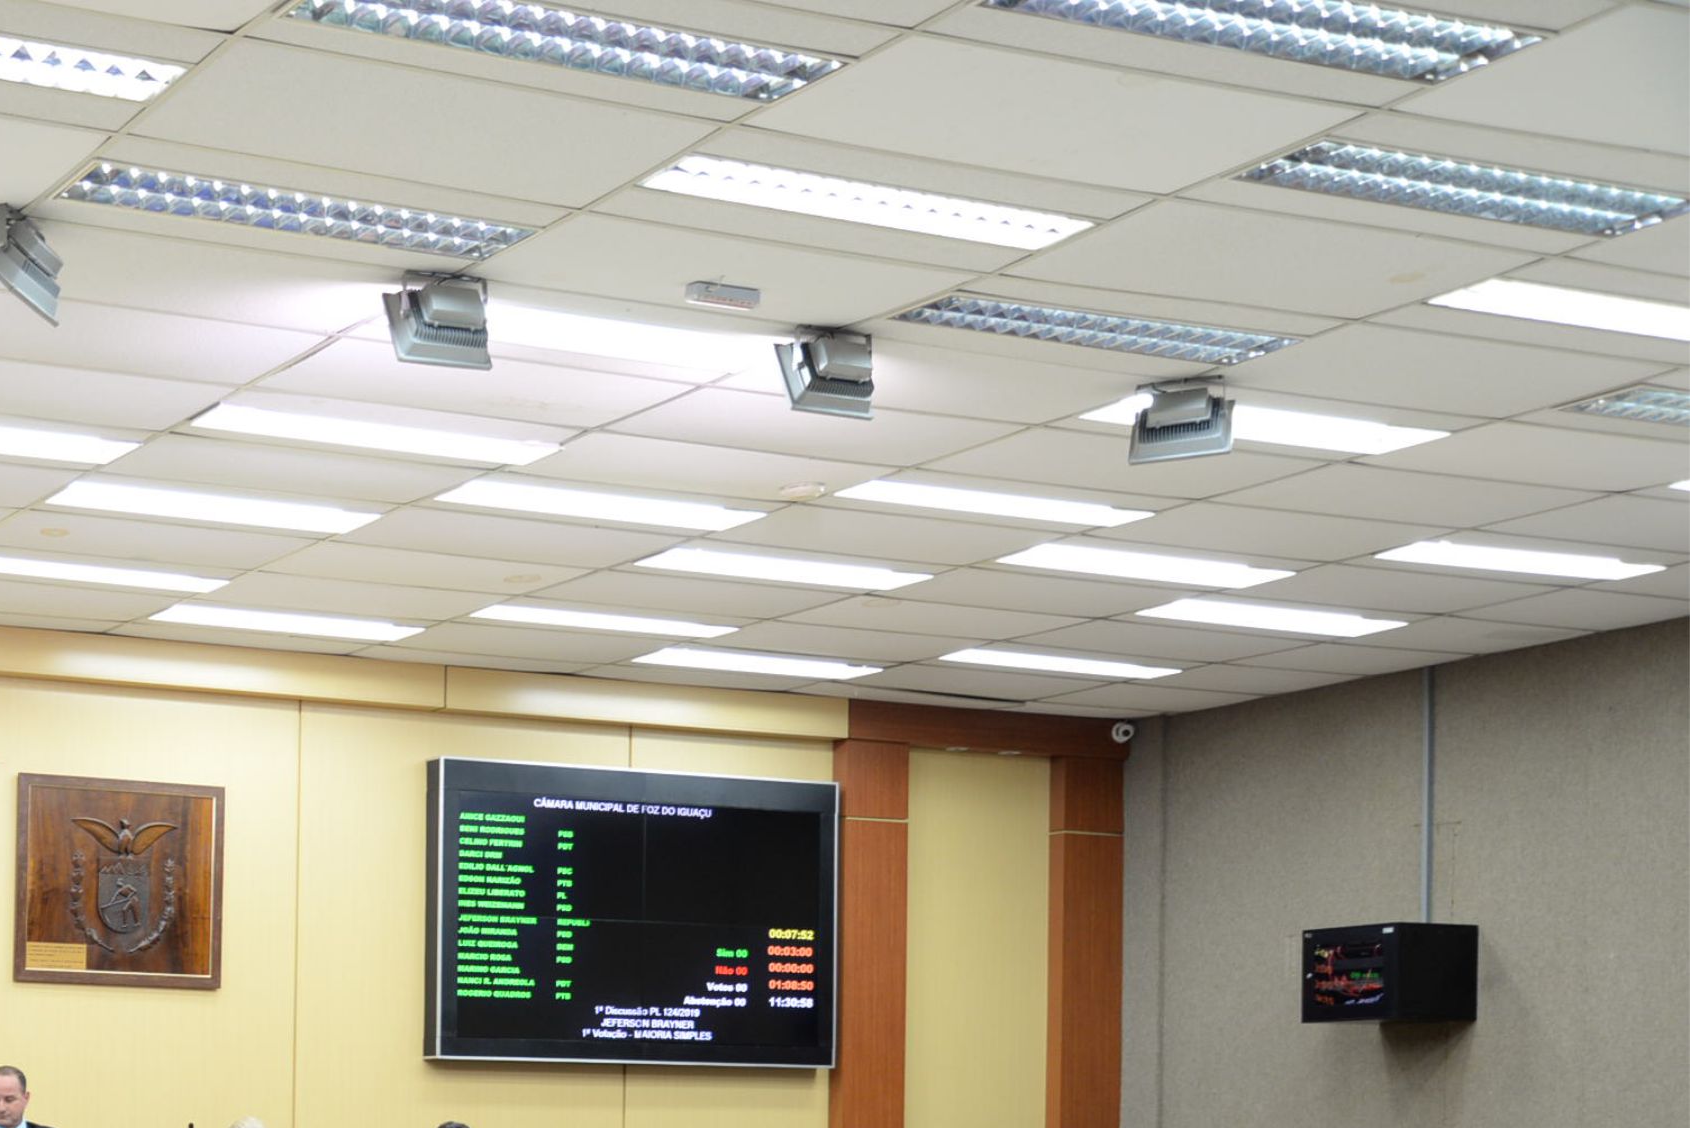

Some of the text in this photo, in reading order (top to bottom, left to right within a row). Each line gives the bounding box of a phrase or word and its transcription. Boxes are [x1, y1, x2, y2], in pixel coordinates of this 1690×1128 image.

[534, 797, 711, 819] CÂMARA MUNICIPAL DE FOZ DO IGUAÇU
[768, 928, 814, 940] 00:07:52
[716, 948, 748, 958] Sim 00
[768, 946, 813, 957] 00:03:00
[736, 966, 748, 976] 00
[650, 1007, 661, 1016] PL
[601, 1018, 694, 1029] JEFERSON BRAYNER
[634, 1030, 672, 1039] MAIORIA
[674, 1031, 712, 1040] SIMPLES
